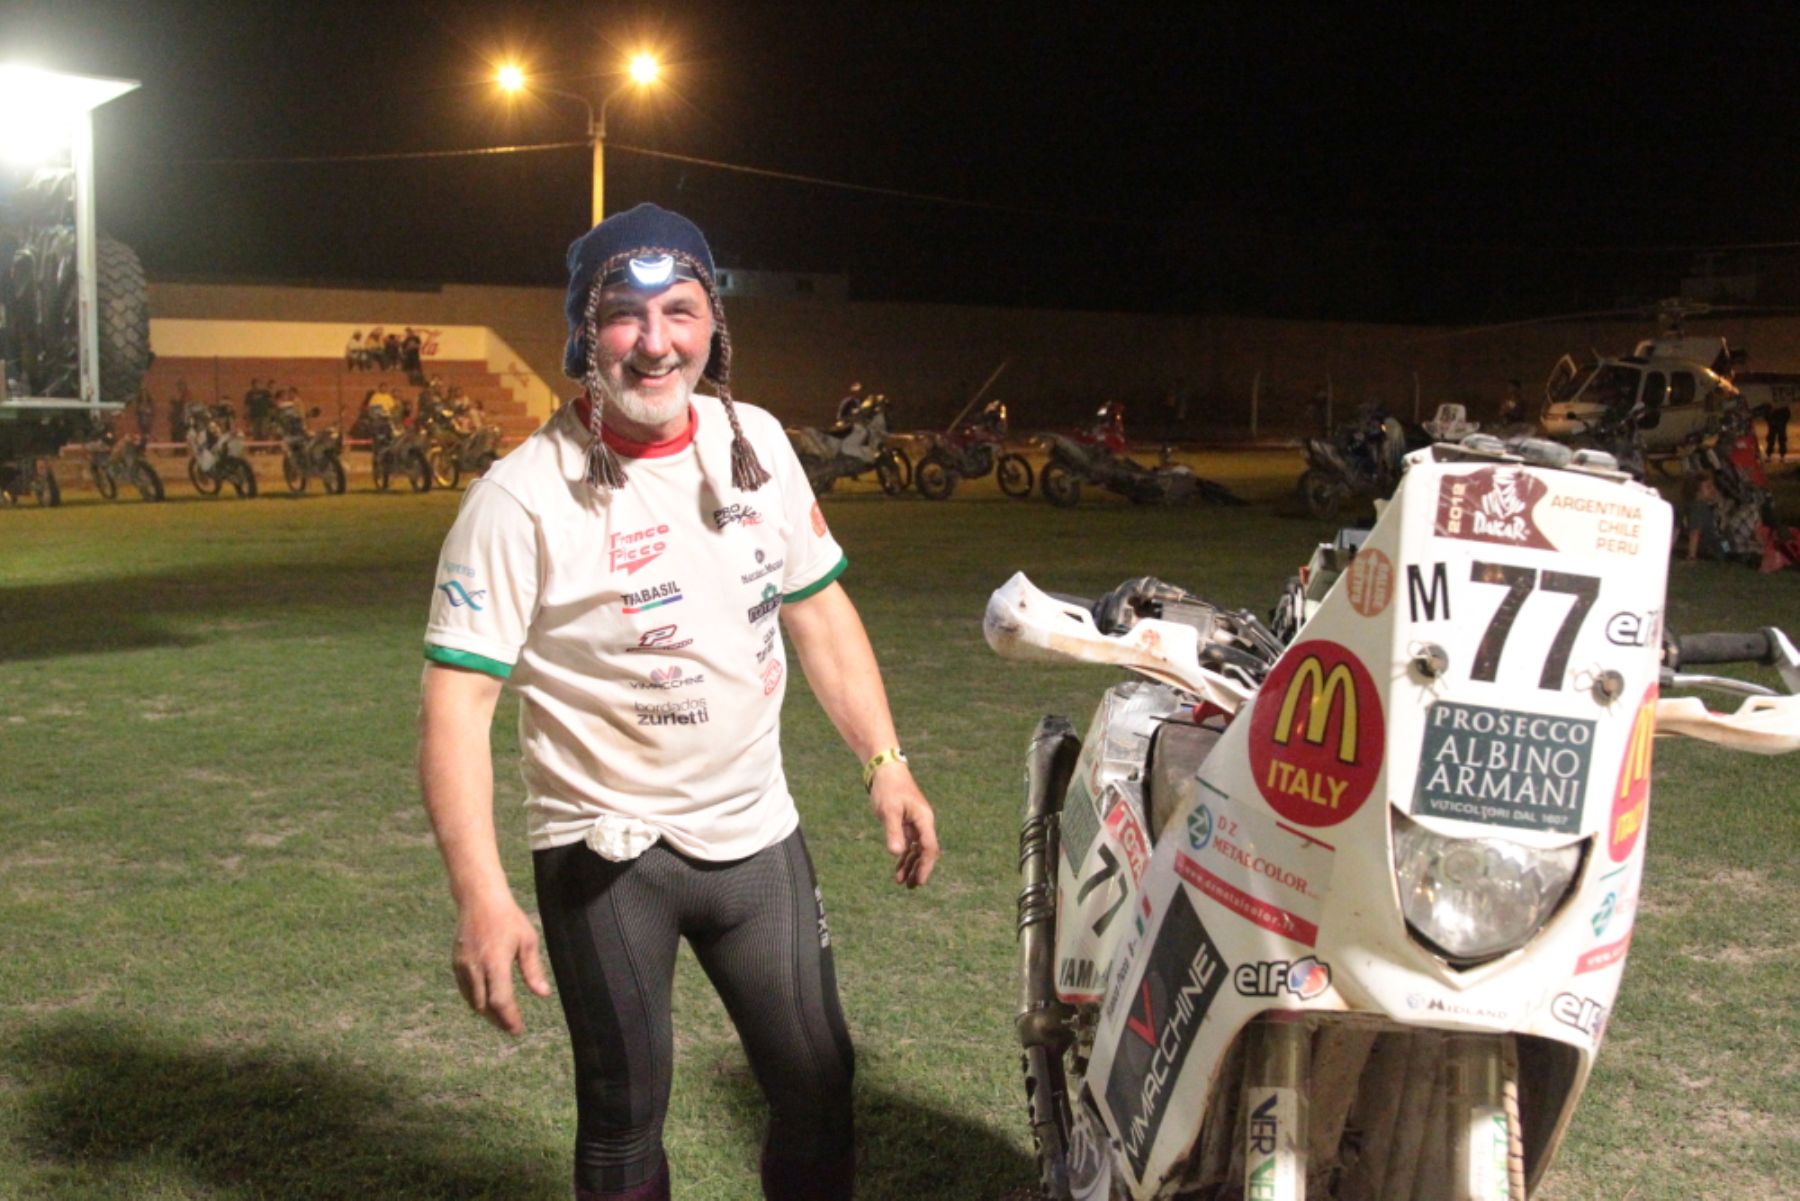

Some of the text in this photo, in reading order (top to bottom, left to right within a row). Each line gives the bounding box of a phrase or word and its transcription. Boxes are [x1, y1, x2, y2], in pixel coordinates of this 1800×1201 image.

[1551, 494, 1642, 520] ARGENTINA
[1596, 537, 1639, 556] PERU
[1598, 519, 1640, 538] CHILE
[1406, 560, 1602, 691] M 77
[634, 698, 707, 714] bordados
[637, 708, 710, 726] zurletti
[1434, 705, 1590, 745] PROSECCO
[1434, 733, 1580, 778] ALBINO
[1266, 759, 1348, 809] ITALY
[1426, 763, 1580, 810] ARMANI
[1513, 808, 1537, 822] DAL
[1212, 835, 1309, 895] METALCOLOR
[1234, 960, 1290, 996] elf
[1126, 943, 1217, 1158] VIMACCHINE
